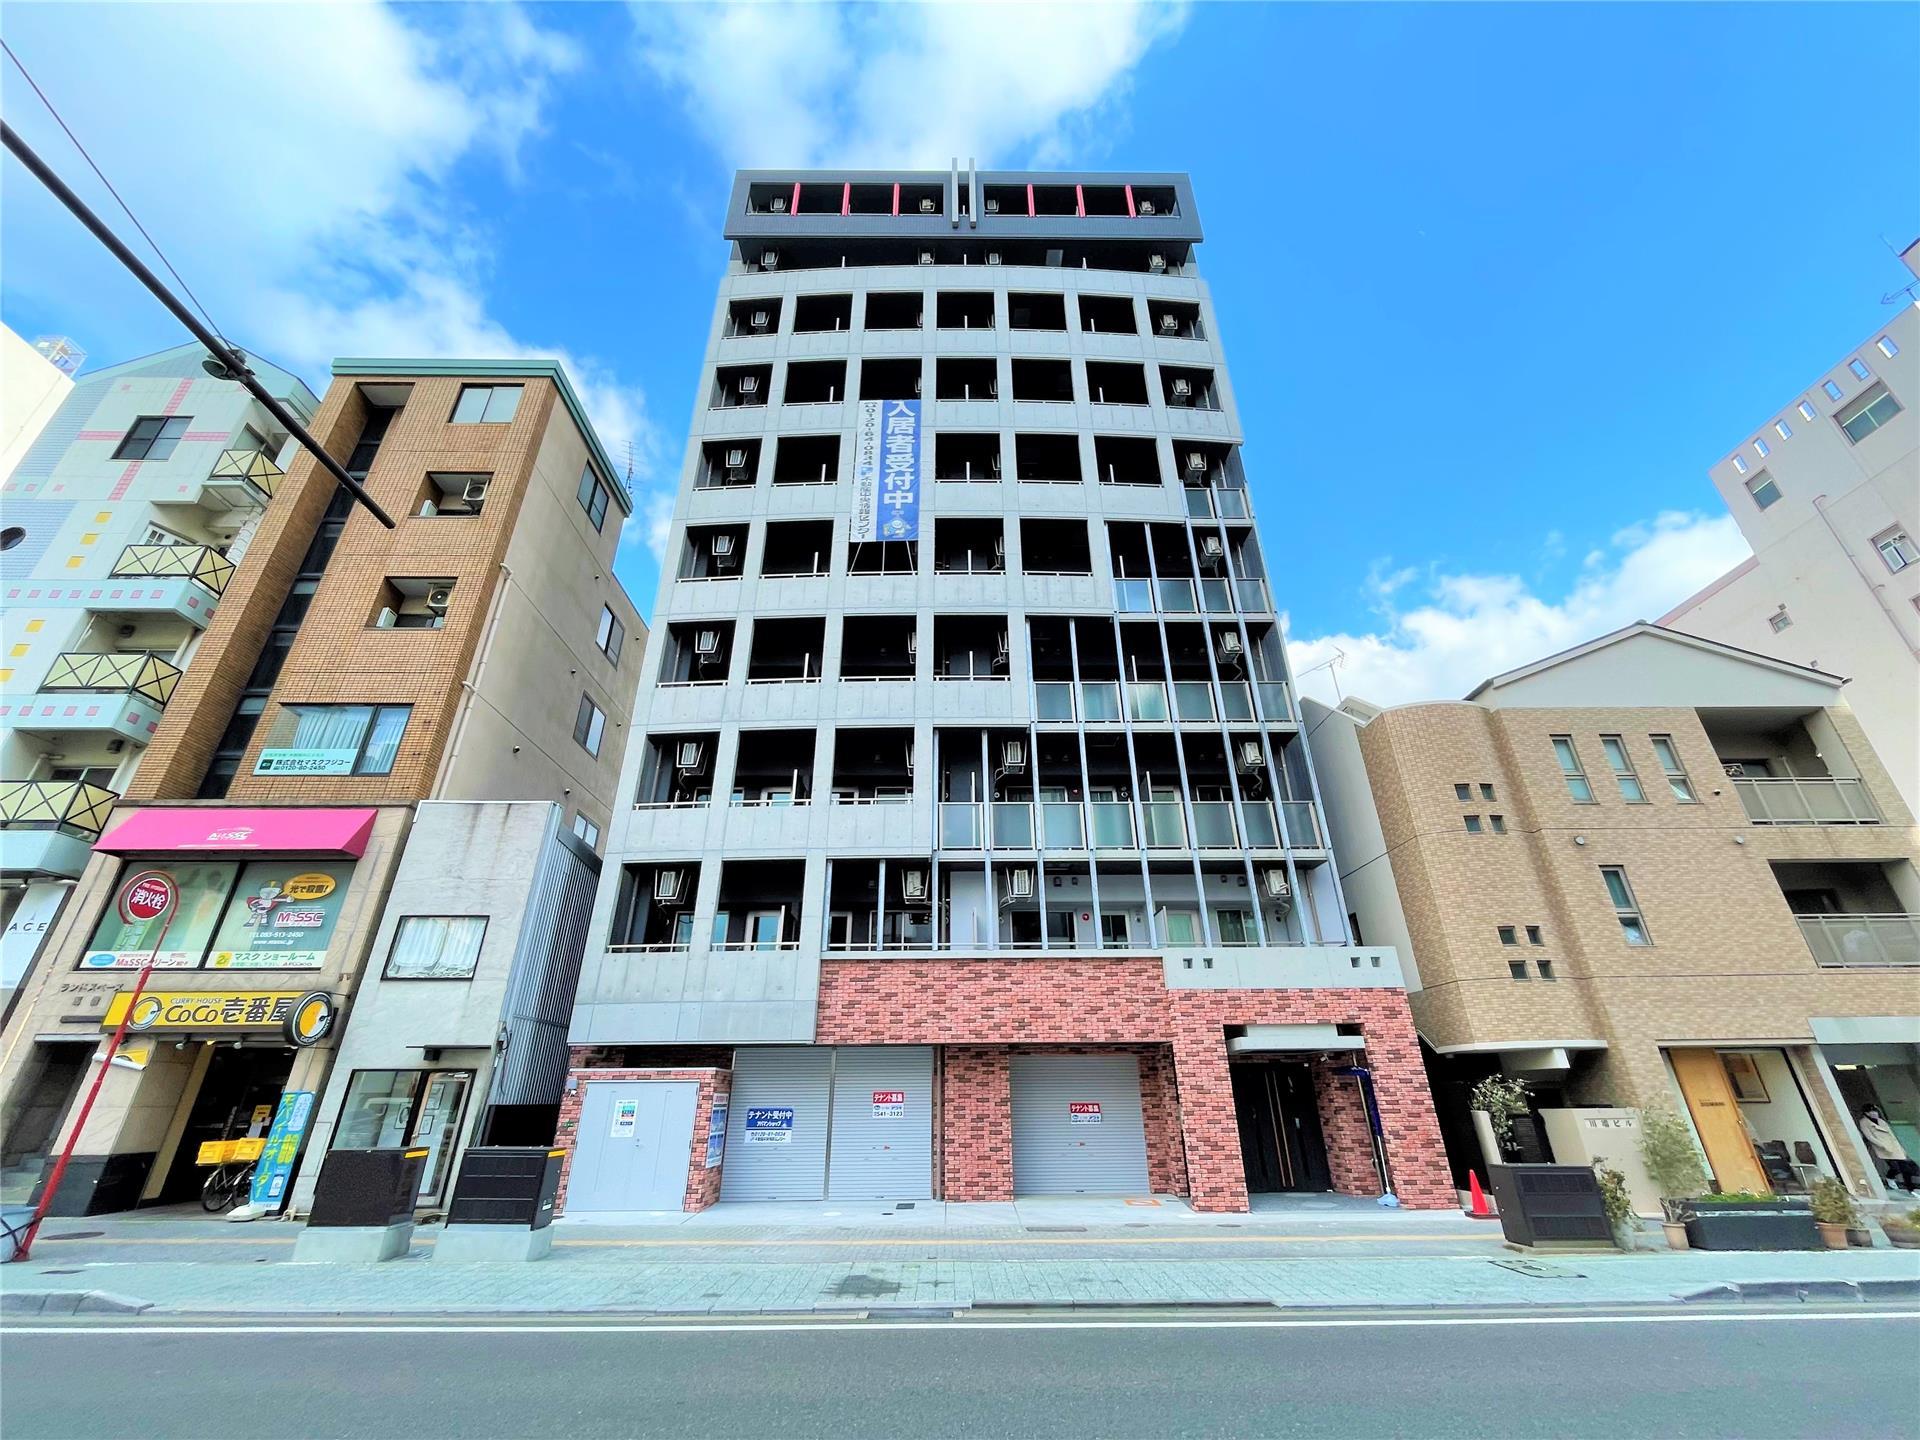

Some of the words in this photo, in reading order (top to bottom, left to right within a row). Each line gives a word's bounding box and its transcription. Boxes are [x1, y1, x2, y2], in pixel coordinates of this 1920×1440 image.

[883, 400, 916, 509] 入居者受付中
[275, 758, 351, 766] 株式会社マスクフジコー
[131, 888, 166, 910] 消火栓
[234, 952, 261, 961] マスク
[263, 952, 316, 961] ショールーム
[748, 1110, 793, 1120] テナント受付中
